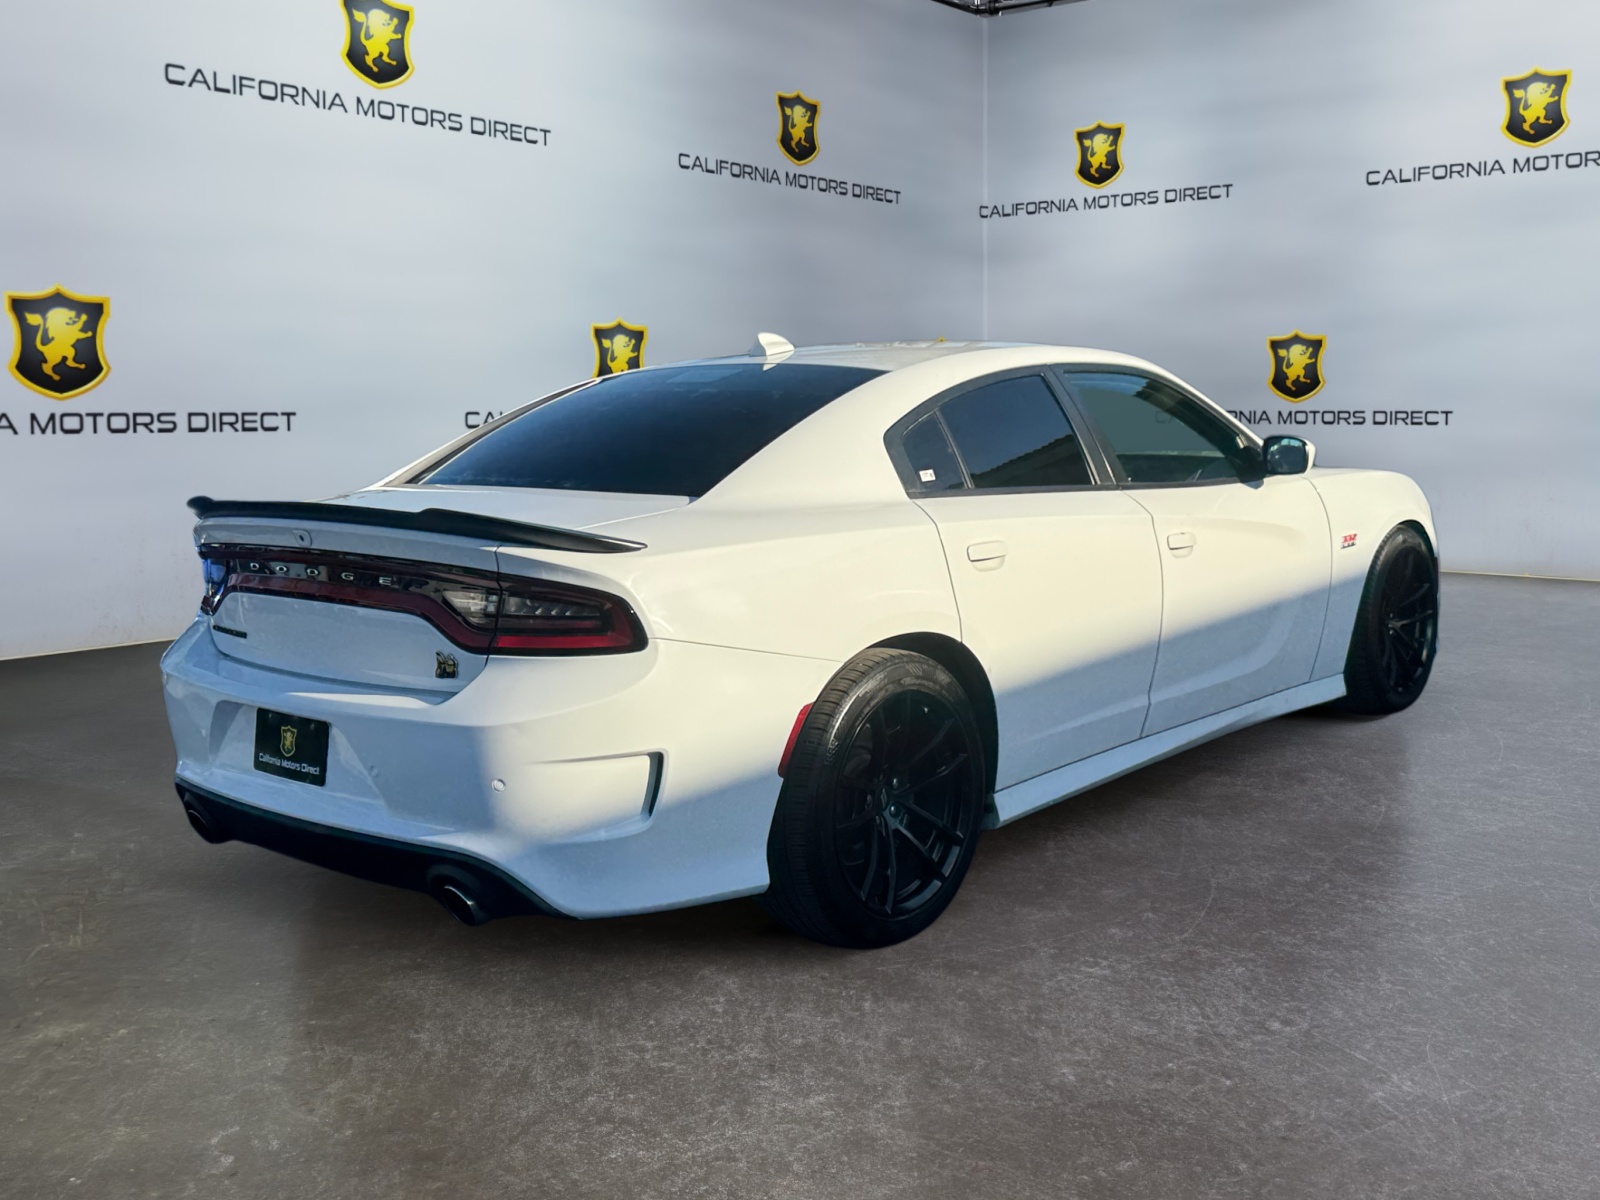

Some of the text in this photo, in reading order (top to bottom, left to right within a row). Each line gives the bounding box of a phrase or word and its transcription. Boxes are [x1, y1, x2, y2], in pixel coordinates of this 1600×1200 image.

[163, 62, 552, 147] CALIFORNIA MOTORS DIRECT
[677, 152, 902, 205] CALIFORNIA MOTORS DIRECT
[1365, 150, 1600, 187] CALIFORNIA MOTOR
[978, 183, 1234, 220] CALIFORNIA MOTORS DIRECT
[29, 411, 178, 436] MOTORS
[186, 411, 297, 433] DIRECT
[1277, 410, 1367, 426] MOTORS
[1372, 410, 1454, 426] DIRECT
[249, 562, 392, 586] DODGE
[258, 752, 320, 775] California Motors Direct
